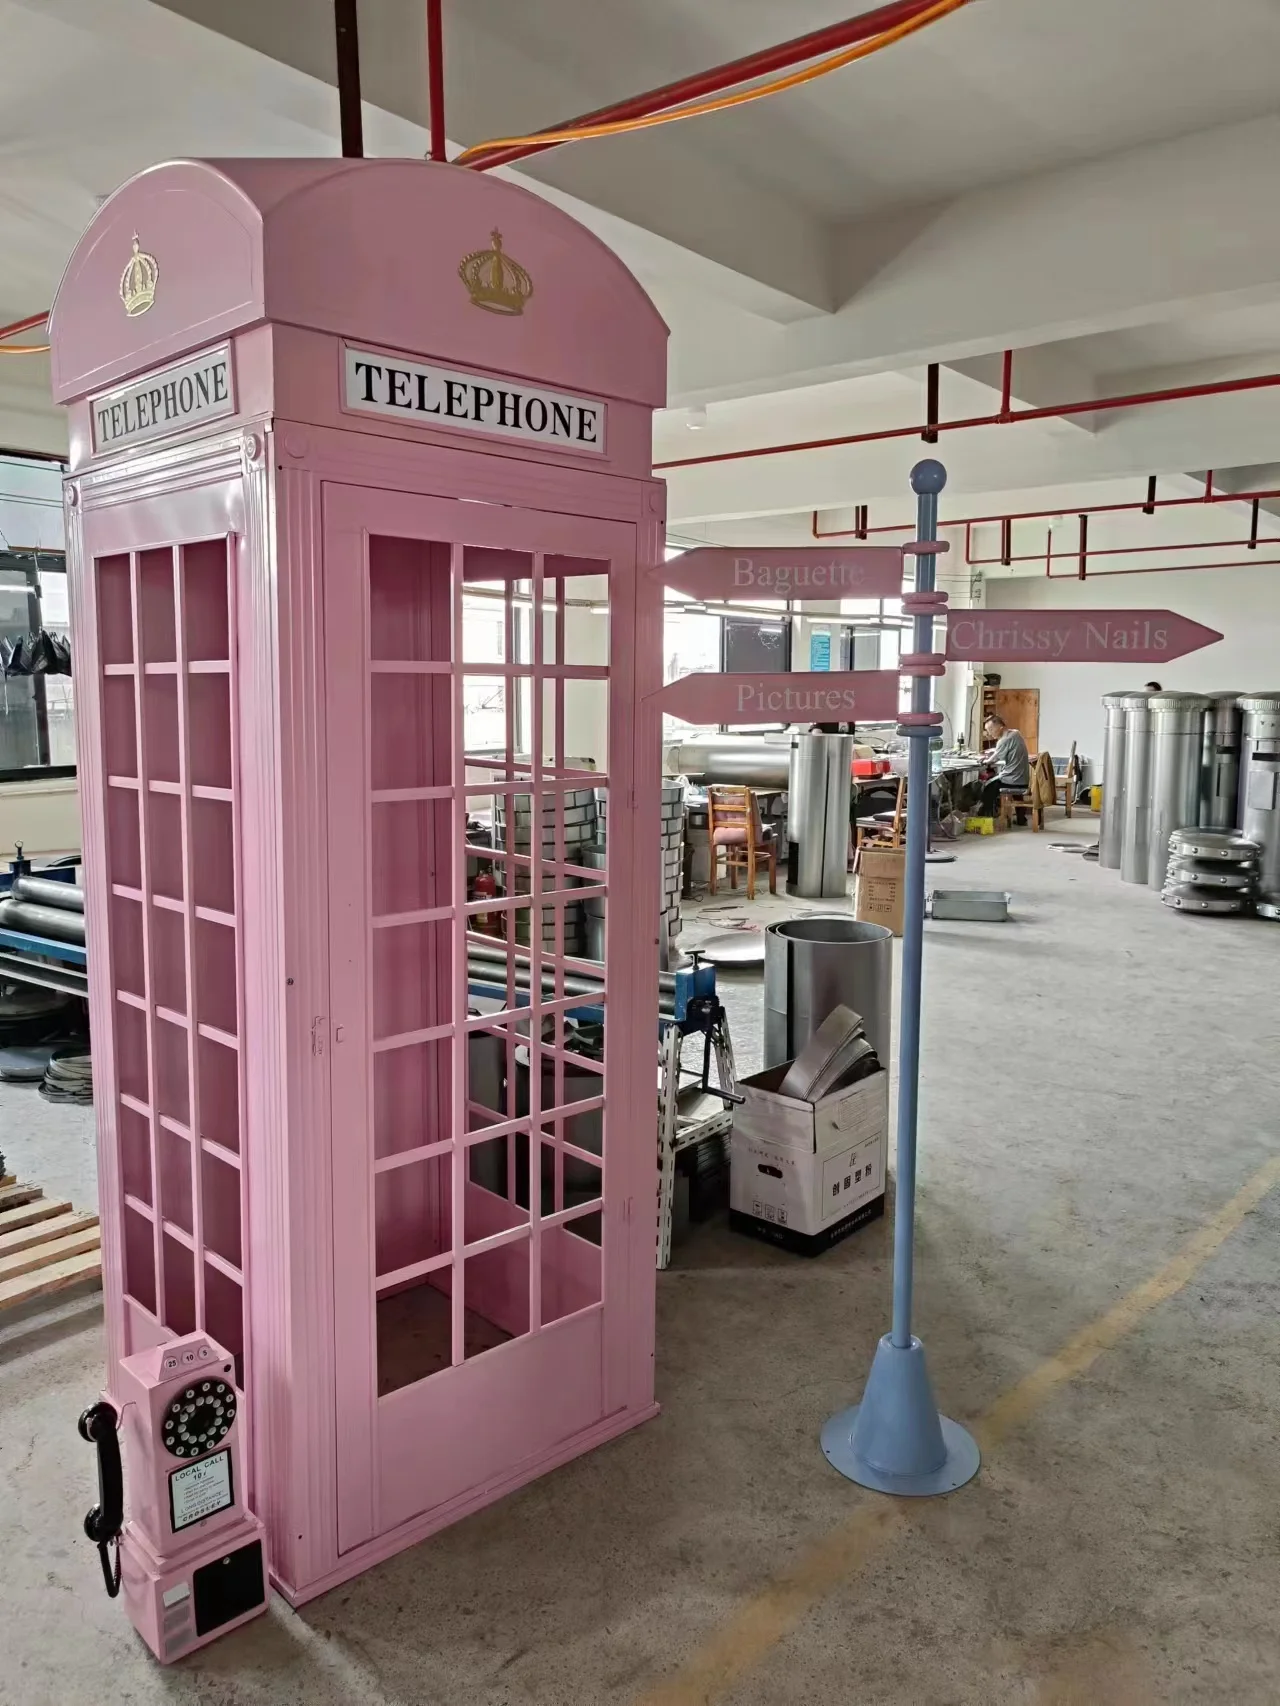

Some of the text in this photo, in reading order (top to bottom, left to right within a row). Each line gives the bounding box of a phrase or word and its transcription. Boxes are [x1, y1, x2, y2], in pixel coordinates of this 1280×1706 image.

[97, 361, 229, 443] TELEPHONE
[354, 361, 599, 444] TELEPHONE
[732, 557, 866, 593] Baguette
[950, 621, 1169, 656] Chrissy Nails
[735, 683, 857, 713] Pictures
[168, 1359, 177, 1368] 25
[175, 1455, 224, 1482] LOCAL CALL
